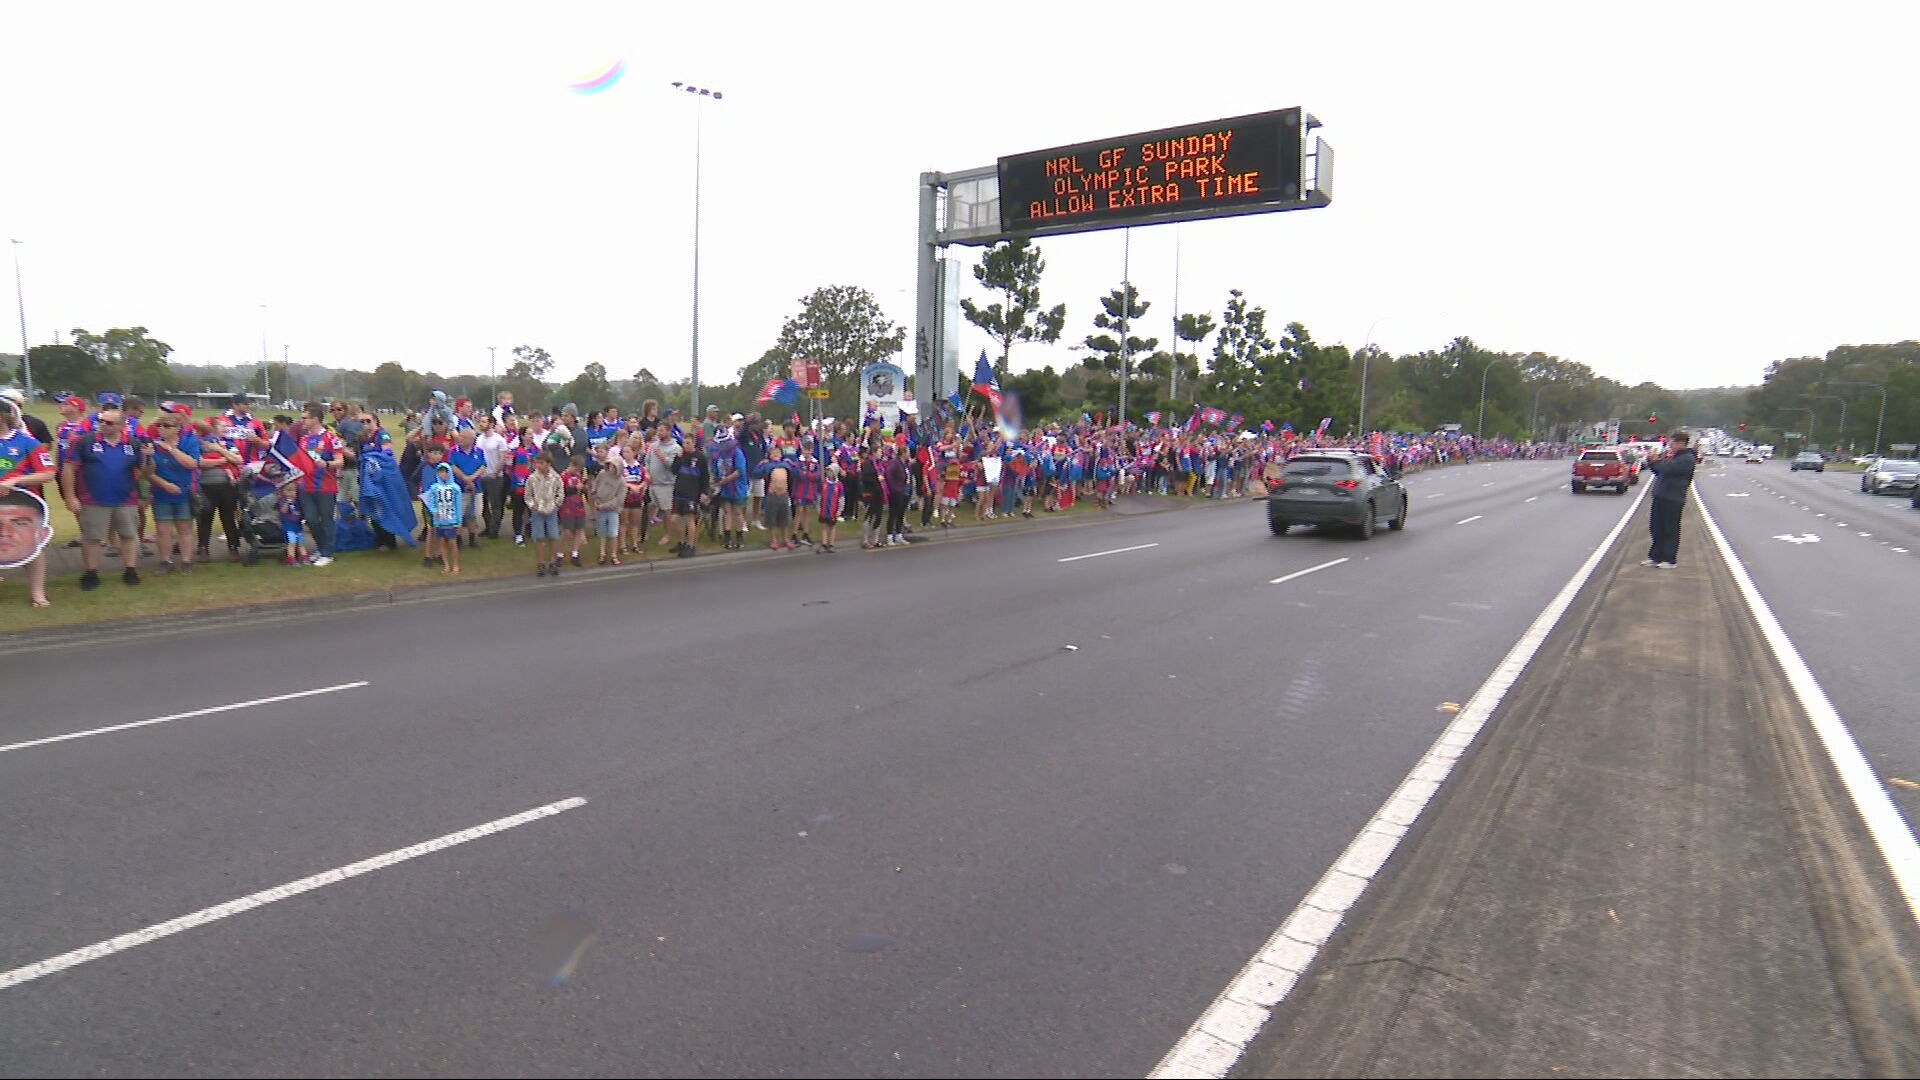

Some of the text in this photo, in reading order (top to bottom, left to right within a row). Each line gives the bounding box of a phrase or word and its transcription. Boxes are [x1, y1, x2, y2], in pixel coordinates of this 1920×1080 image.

[1045, 130, 1233, 177] NRL GF SUNDAY
[1054, 154, 1227, 196] OLYMPIC PARK
[1030, 171, 1260, 219] ALLOW EXTRA TIME
